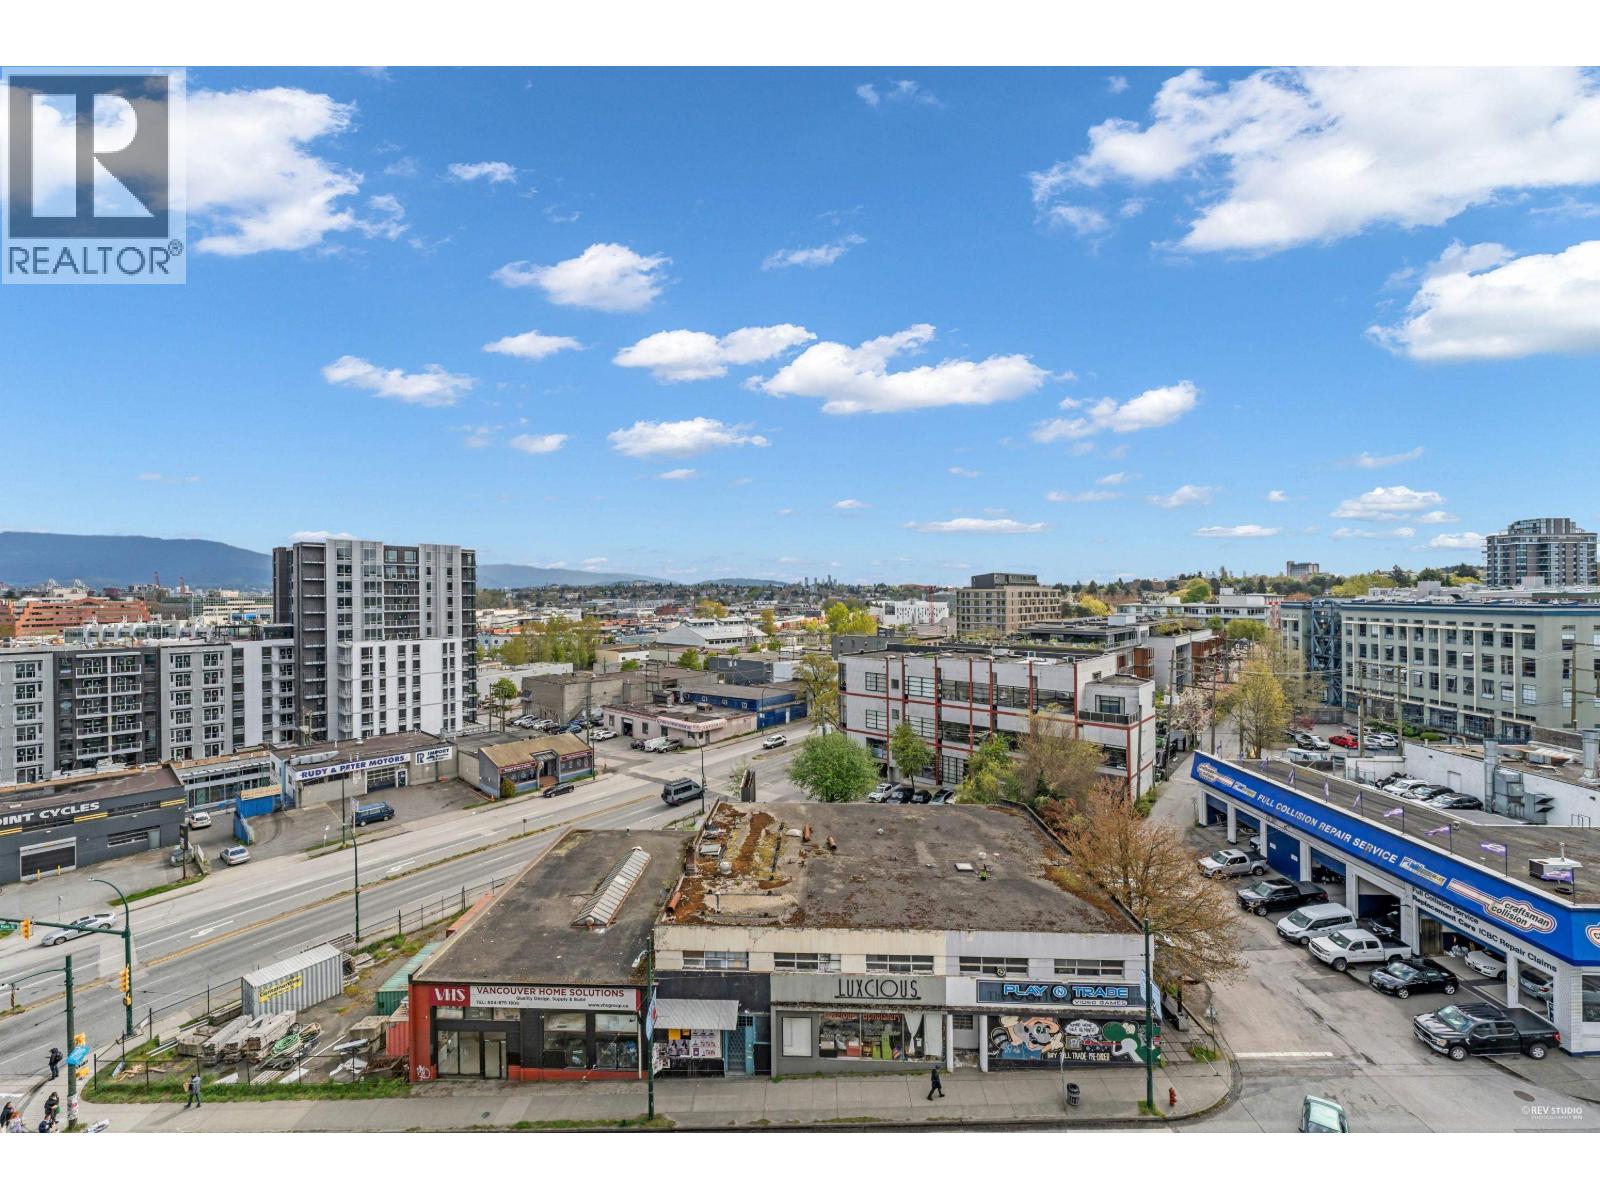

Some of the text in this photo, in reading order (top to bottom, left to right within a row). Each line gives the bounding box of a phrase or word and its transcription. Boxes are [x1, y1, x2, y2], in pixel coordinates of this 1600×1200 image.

[301, 768, 327, 778] RUDY
[369, 755, 404, 767] MOTORS
[0, 802, 99, 826] INT CYCLES
[1257, 794, 1399, 864] FULL COLLISION REPAIR SERVICE
[1412, 895, 1476, 932] Replacement Cars
[1424, 891, 1451, 911] Collision
[1452, 905, 1479, 924] Service
[1491, 904, 1528, 926] collision
[1504, 902, 1550, 927] craftsman
[1478, 927, 1557, 973] ICBC Repair Claims
[434, 987, 466, 1002] VHS
[476, 986, 625, 997] VANCOUVER HOME SOLUTIONS
[838, 978, 918, 998] LUXCIOUS
[1003, 985, 1048, 996] PLAY
[1072, 986, 1128, 998] TRADE
[1072, 1052, 1086, 1060] TRADE
